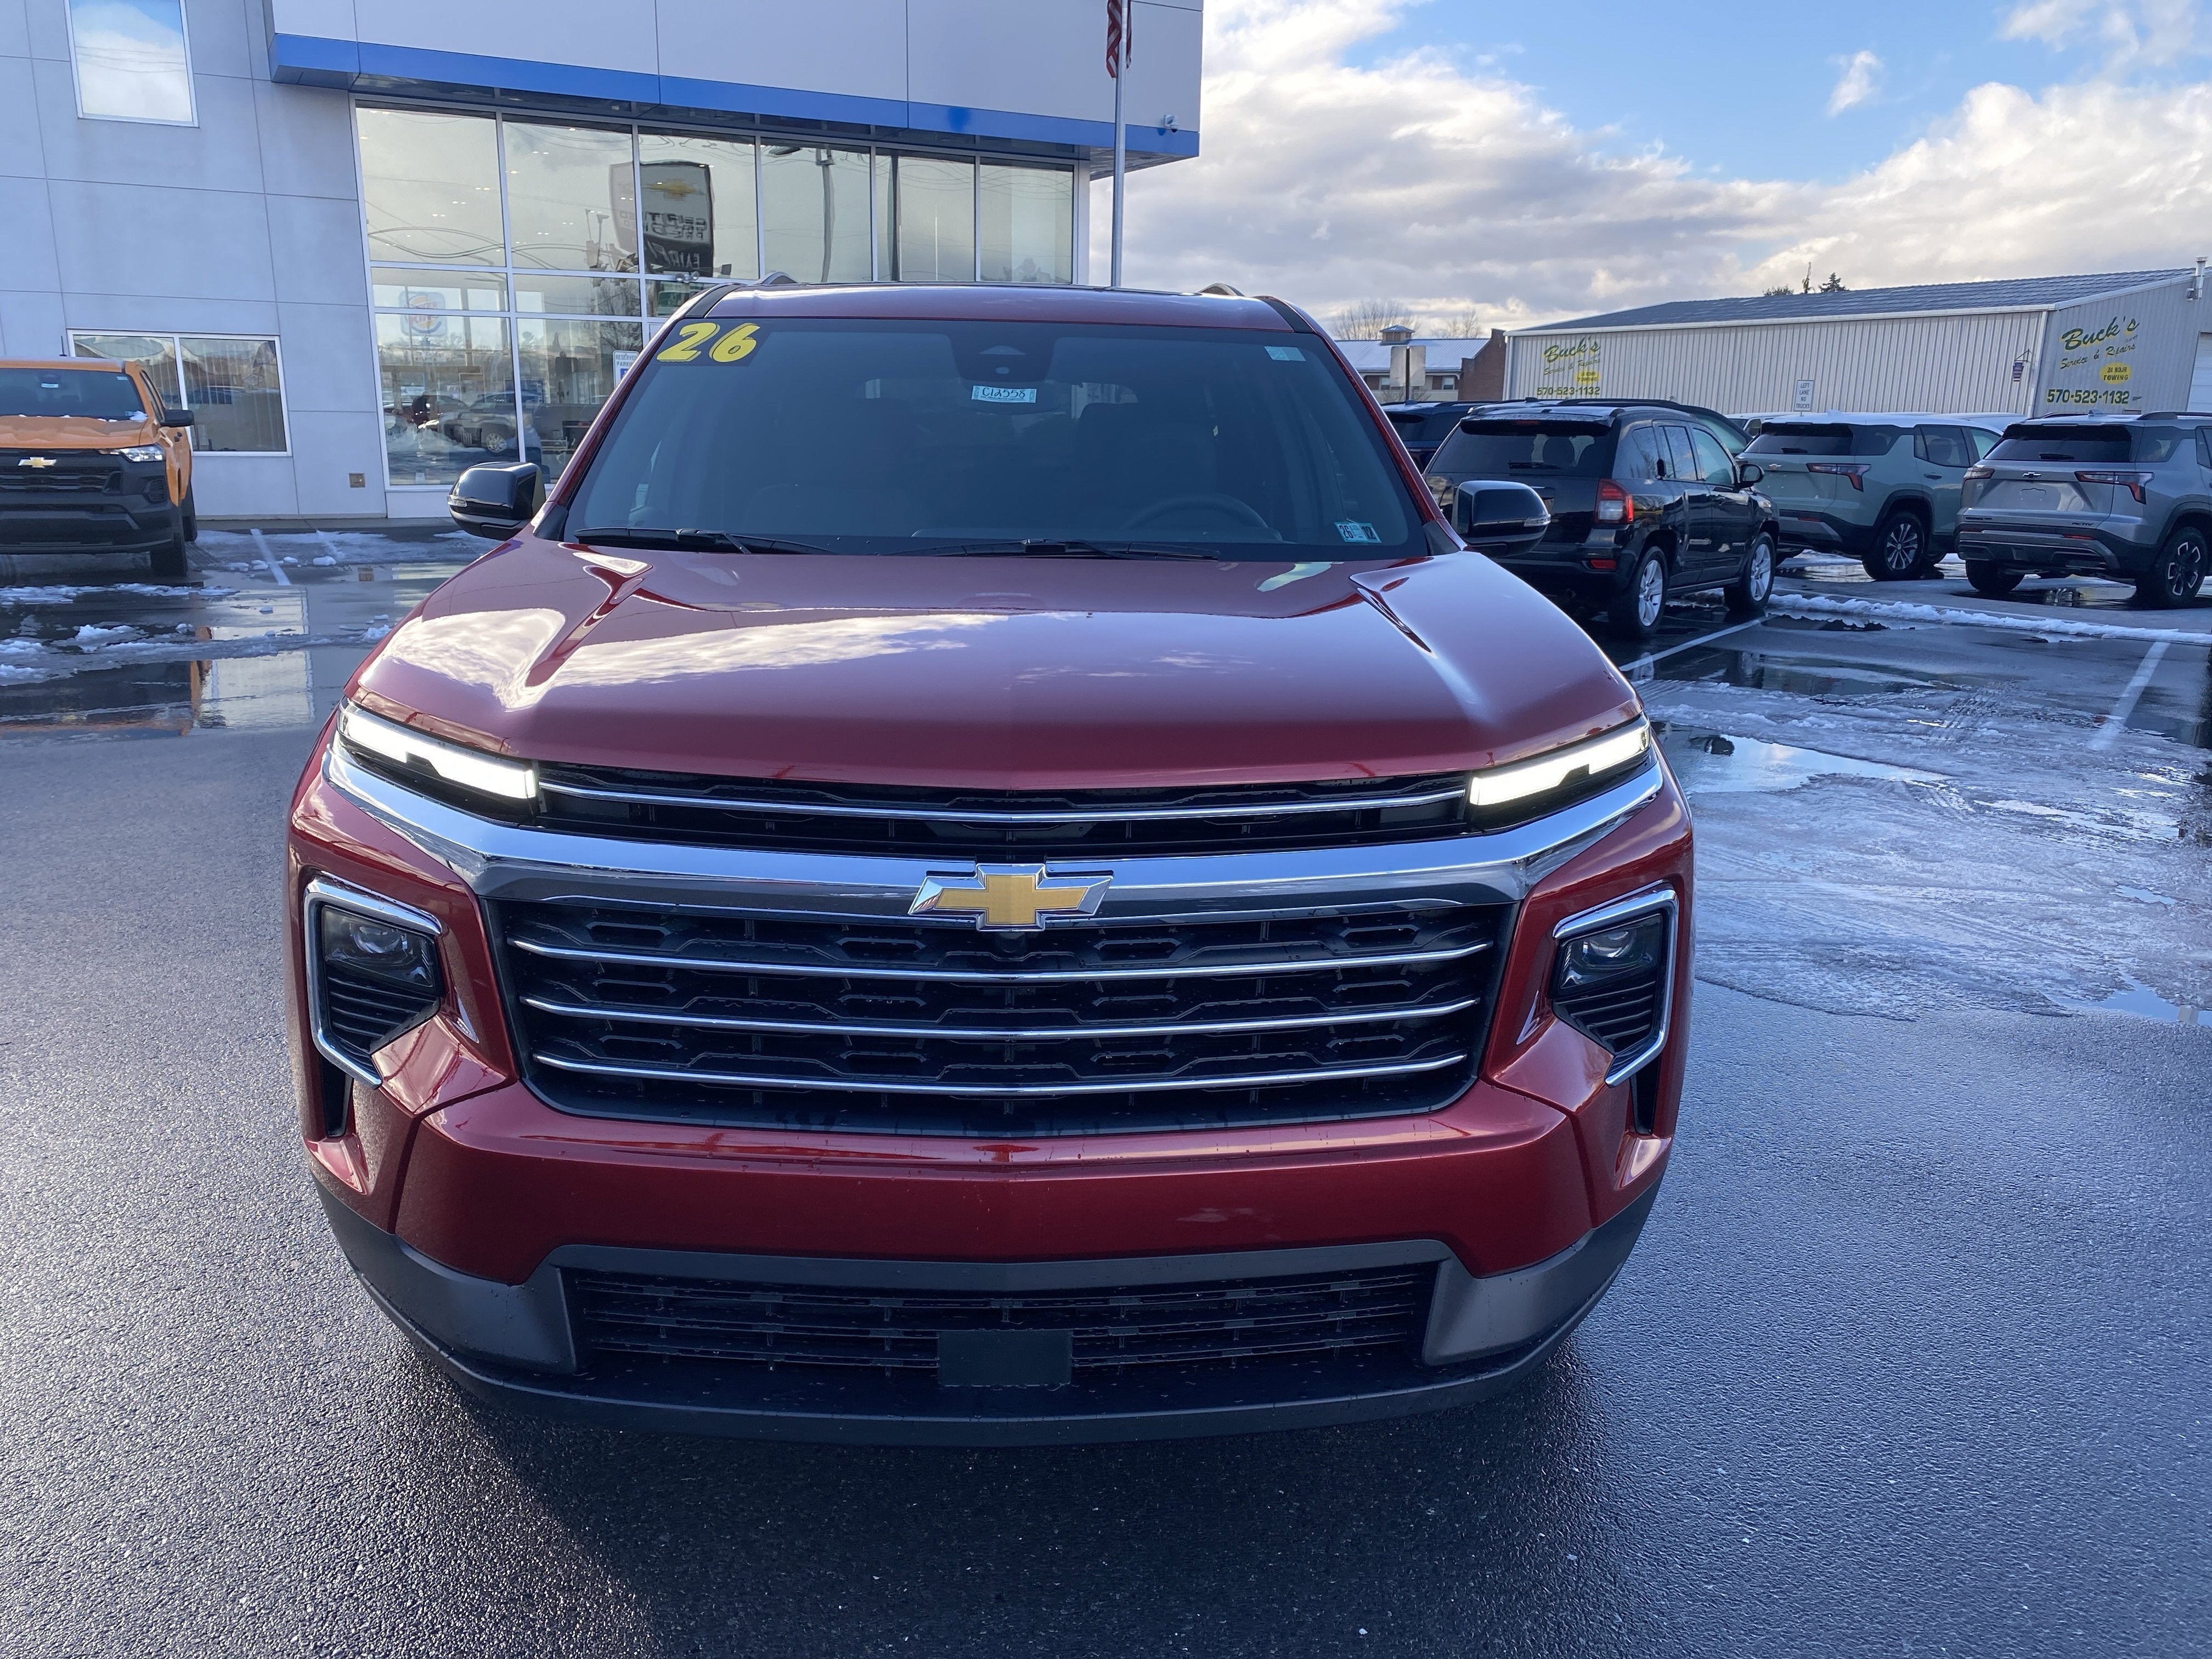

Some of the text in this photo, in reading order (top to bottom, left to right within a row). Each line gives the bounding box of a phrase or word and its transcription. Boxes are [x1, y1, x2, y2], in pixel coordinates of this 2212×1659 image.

[2062, 315, 2140, 350] Buck's
[657, 323, 761, 363] 26
[1544, 336, 1601, 363] Buck's
[2060, 356, 2089, 369] Service
[2106, 343, 2136, 357] Repairs
[982, 387, 1025, 398] C12558
[1537, 386, 1600, 395] 570-523-1132
[2047, 389, 2130, 404] 570-523-1132
[1339, 525, 1354, 539] 26
